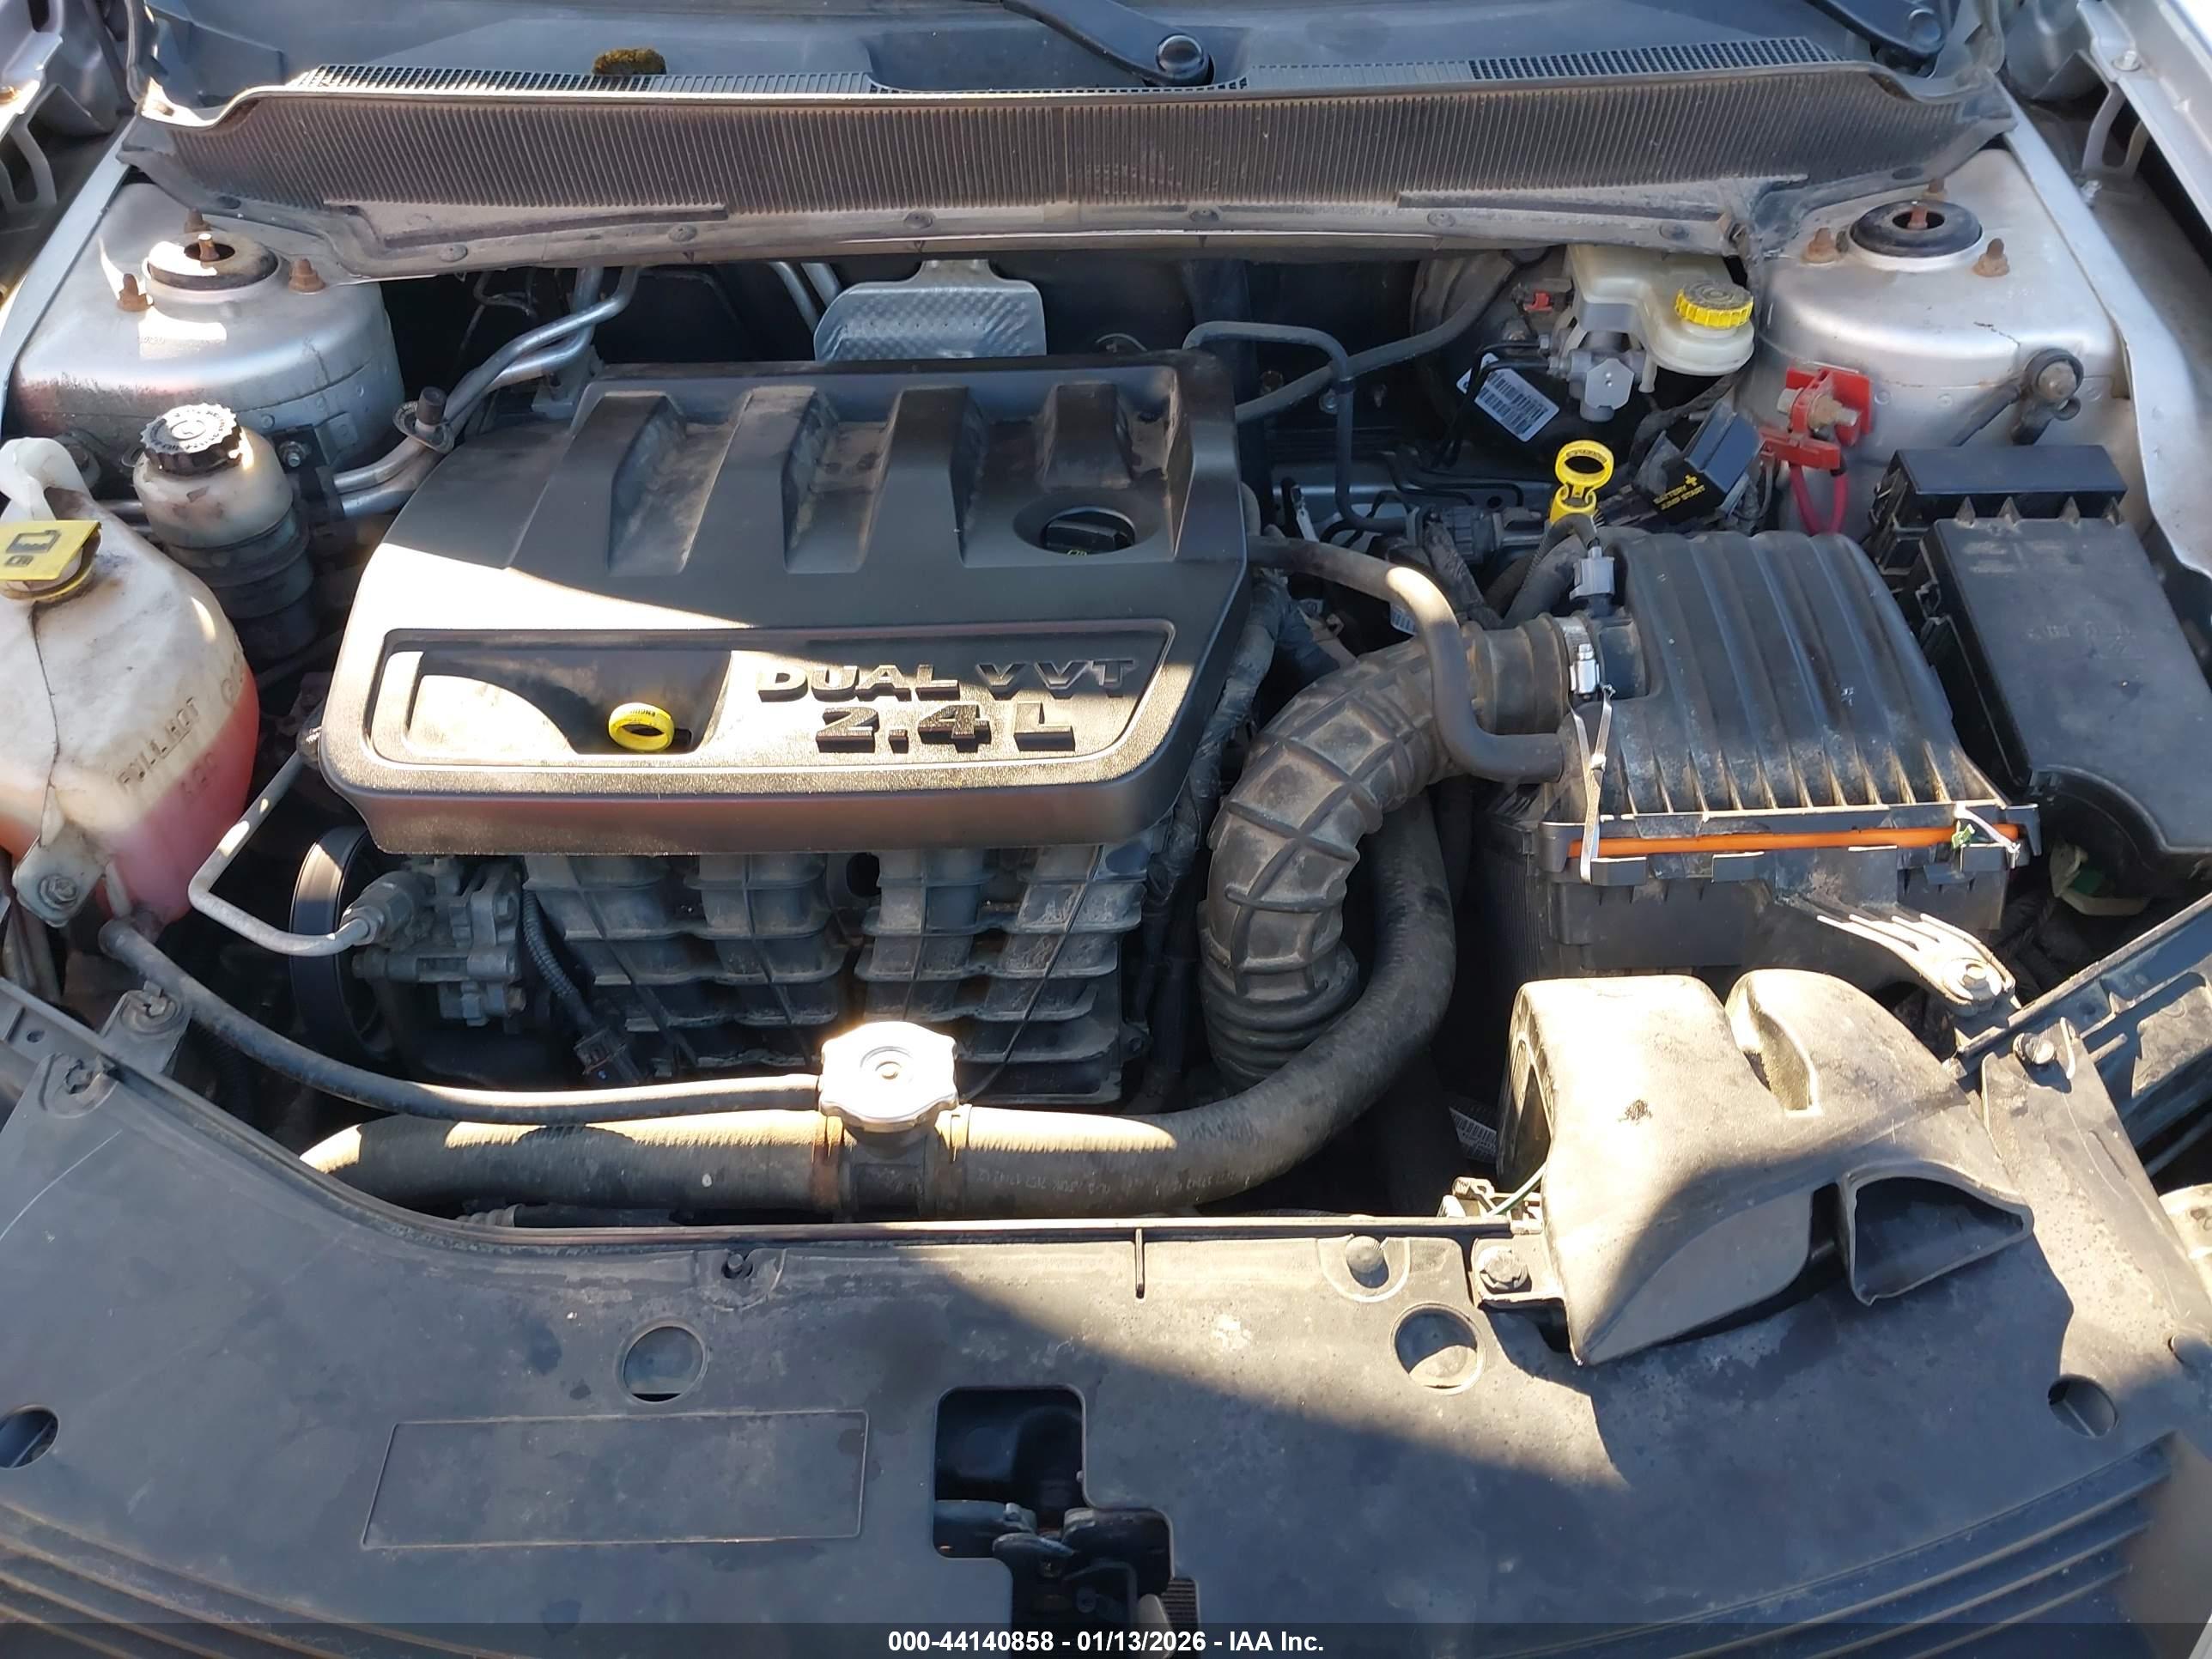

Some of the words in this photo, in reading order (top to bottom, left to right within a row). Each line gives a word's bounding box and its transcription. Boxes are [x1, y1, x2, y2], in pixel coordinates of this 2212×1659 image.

[1680, 484, 1706, 501] START
[757, 664, 961, 702] DUAL
[975, 659, 1135, 701] VVT
[117, 739, 167, 793] FULL
